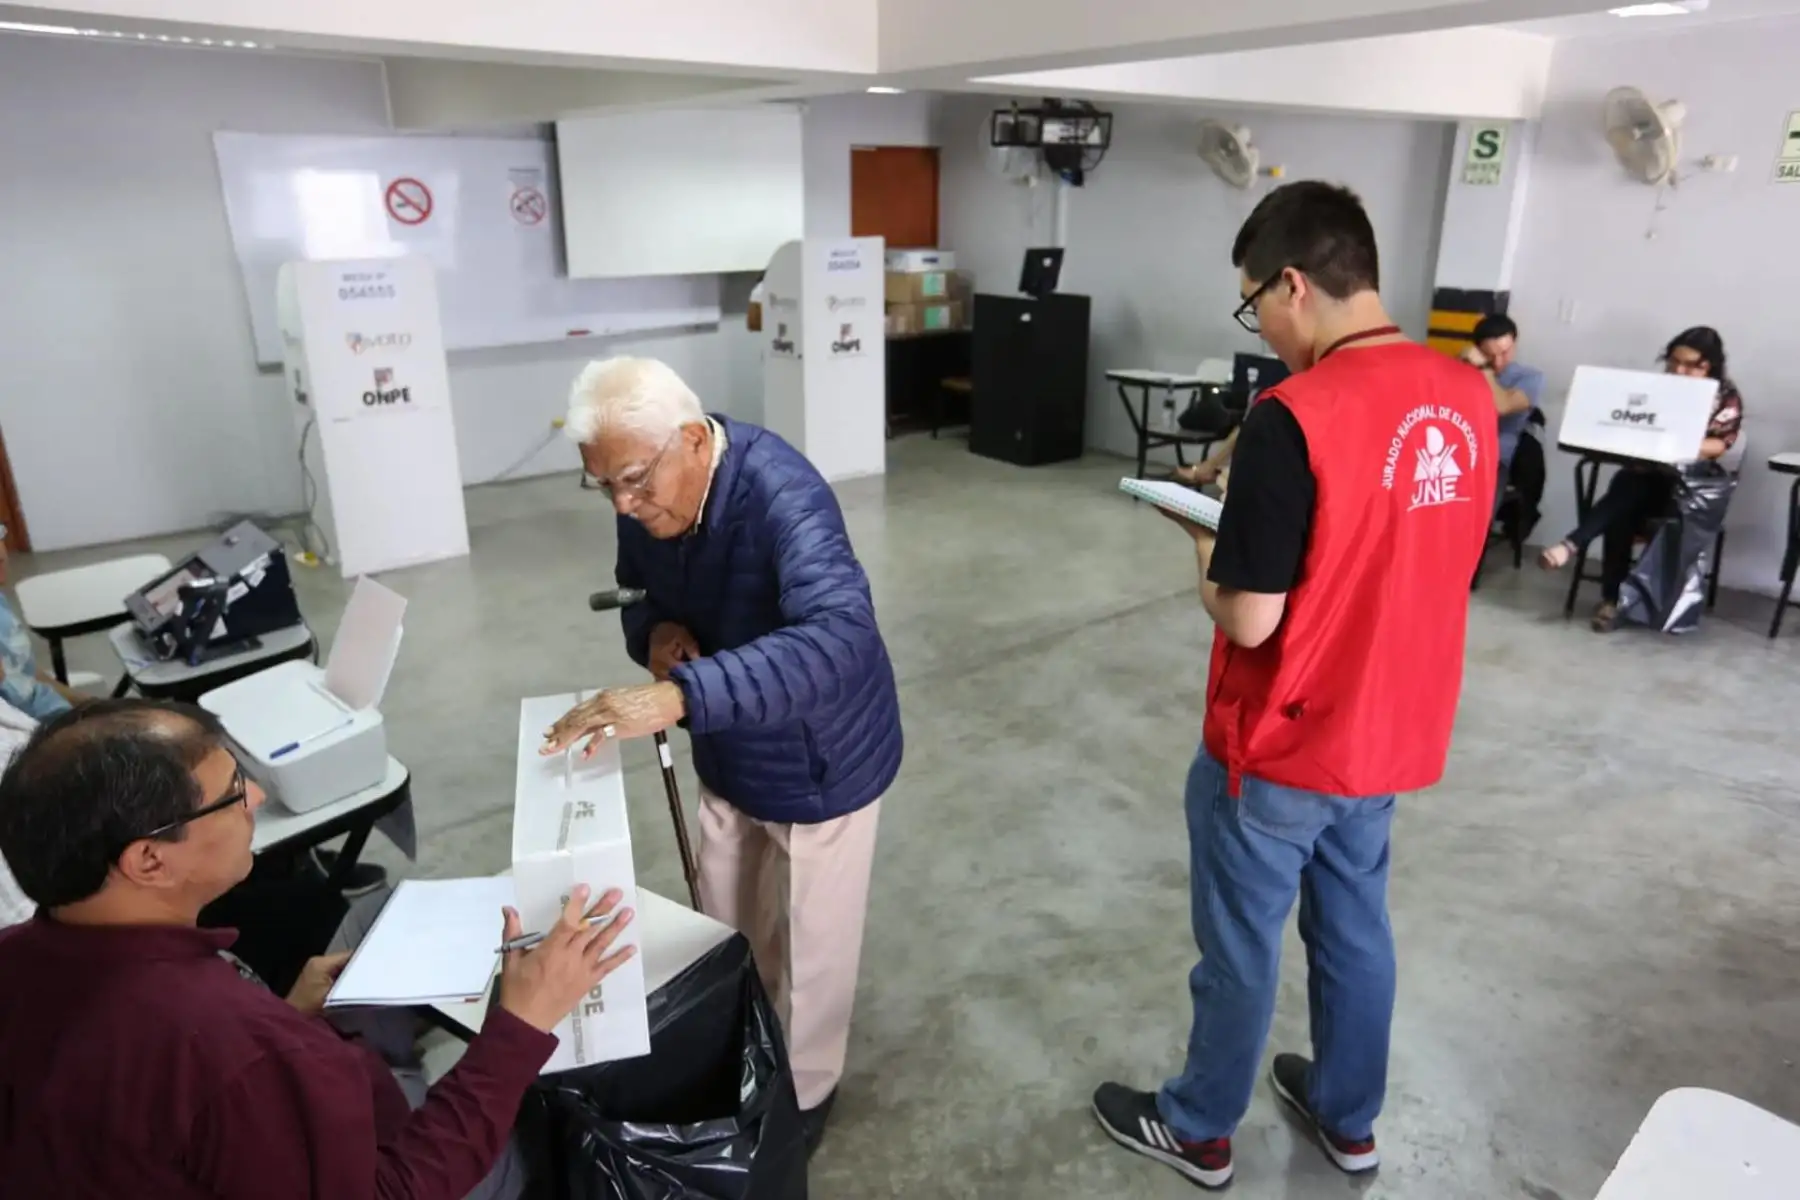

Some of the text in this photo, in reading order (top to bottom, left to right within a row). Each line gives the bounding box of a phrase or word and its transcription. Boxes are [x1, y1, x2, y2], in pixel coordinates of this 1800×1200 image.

[1474, 130, 1500, 159] S
[362, 386, 411, 407] ONPE
[1610, 408, 1657, 425] ONPE
[1381, 437, 1403, 491] JURADO
[1396, 403, 1438, 440] NACIONAL
[1438, 405, 1452, 421] DE
[1411, 476, 1459, 505] JNE
